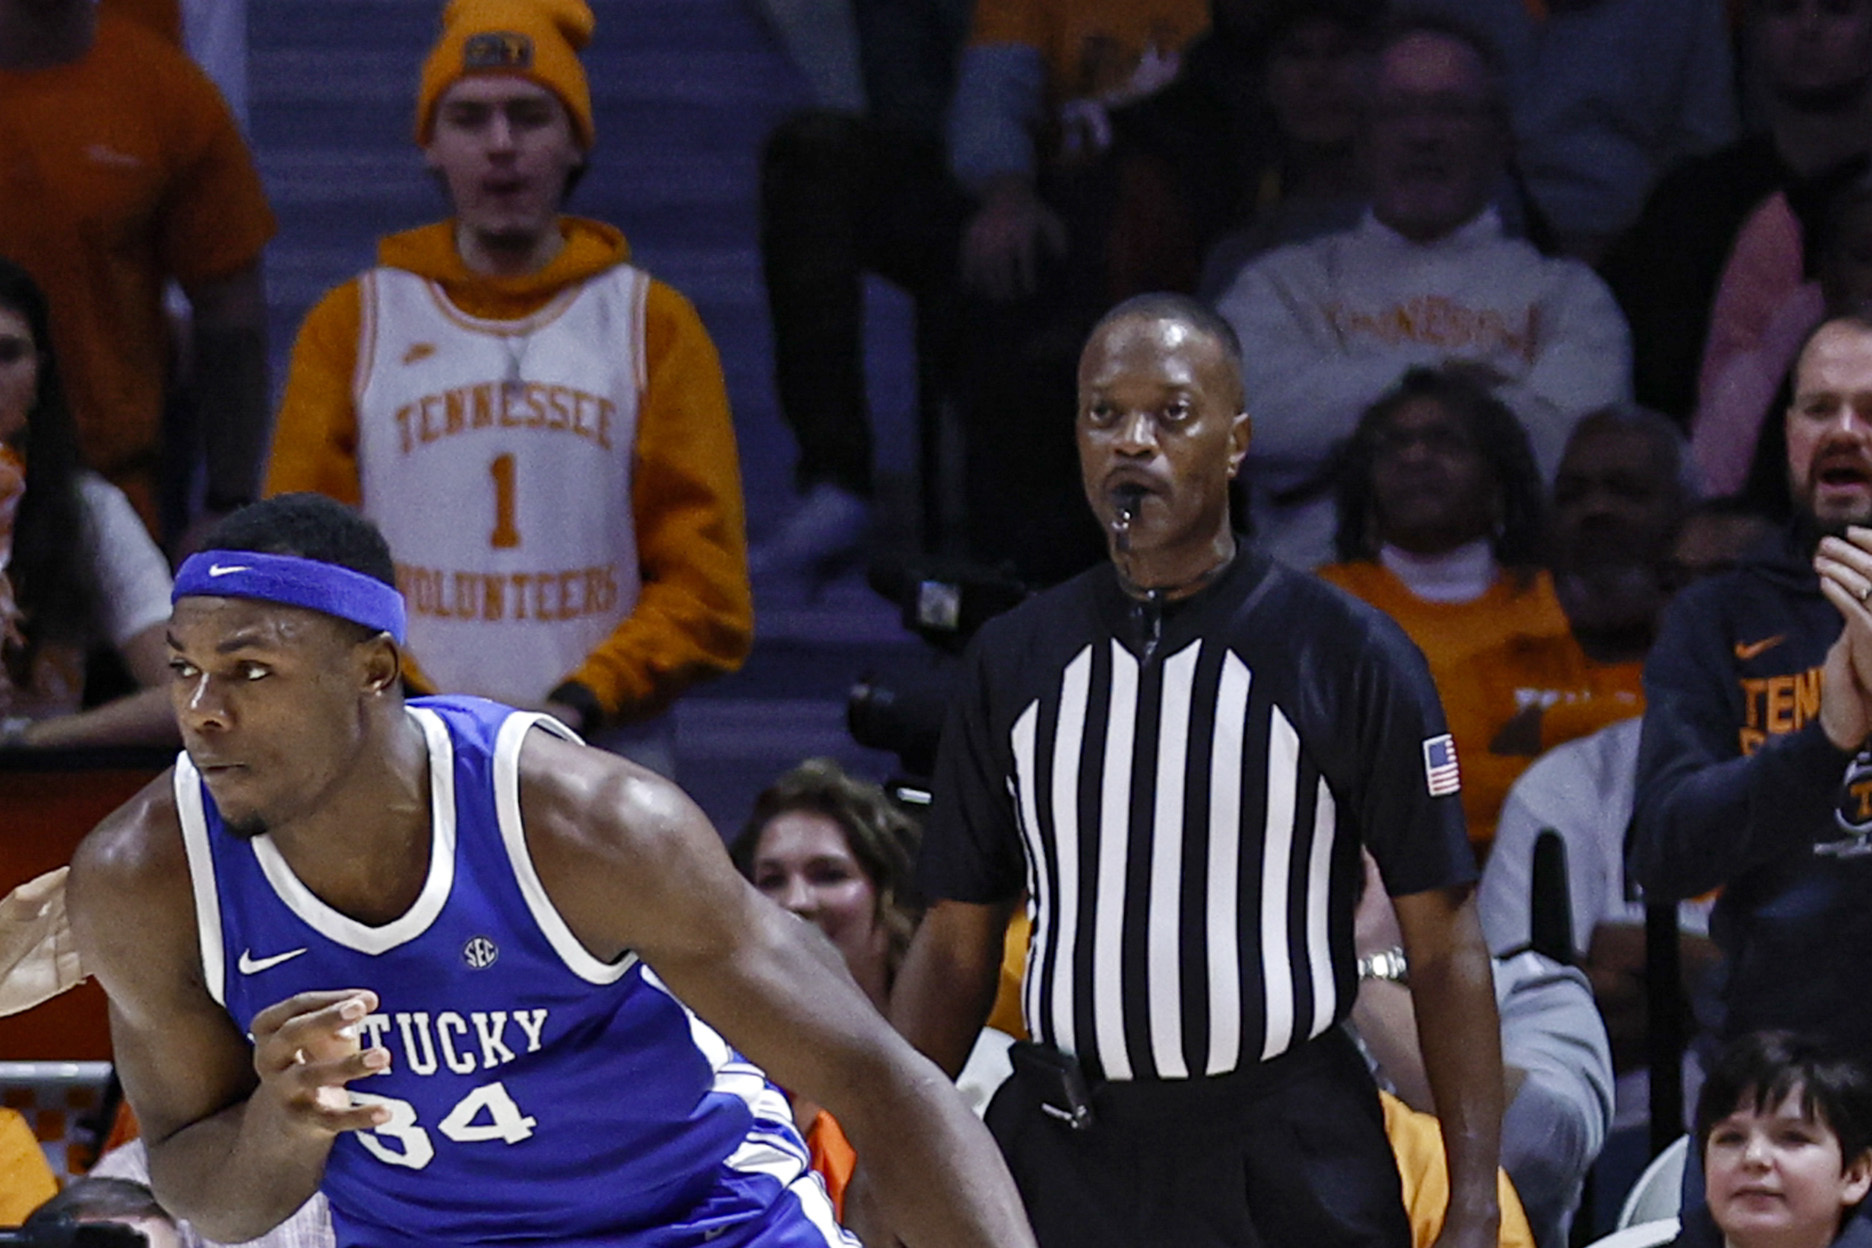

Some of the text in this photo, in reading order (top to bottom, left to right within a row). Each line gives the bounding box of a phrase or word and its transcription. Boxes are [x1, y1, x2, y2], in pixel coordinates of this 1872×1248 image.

[395, 379, 617, 454] TENNESSEE
[490, 452, 522, 549] 1
[1739, 667, 1826, 733] TEN
[463, 936, 498, 968] SEC
[357, 1008, 548, 1076] TUCKY
[347, 1081, 537, 1170] 34
